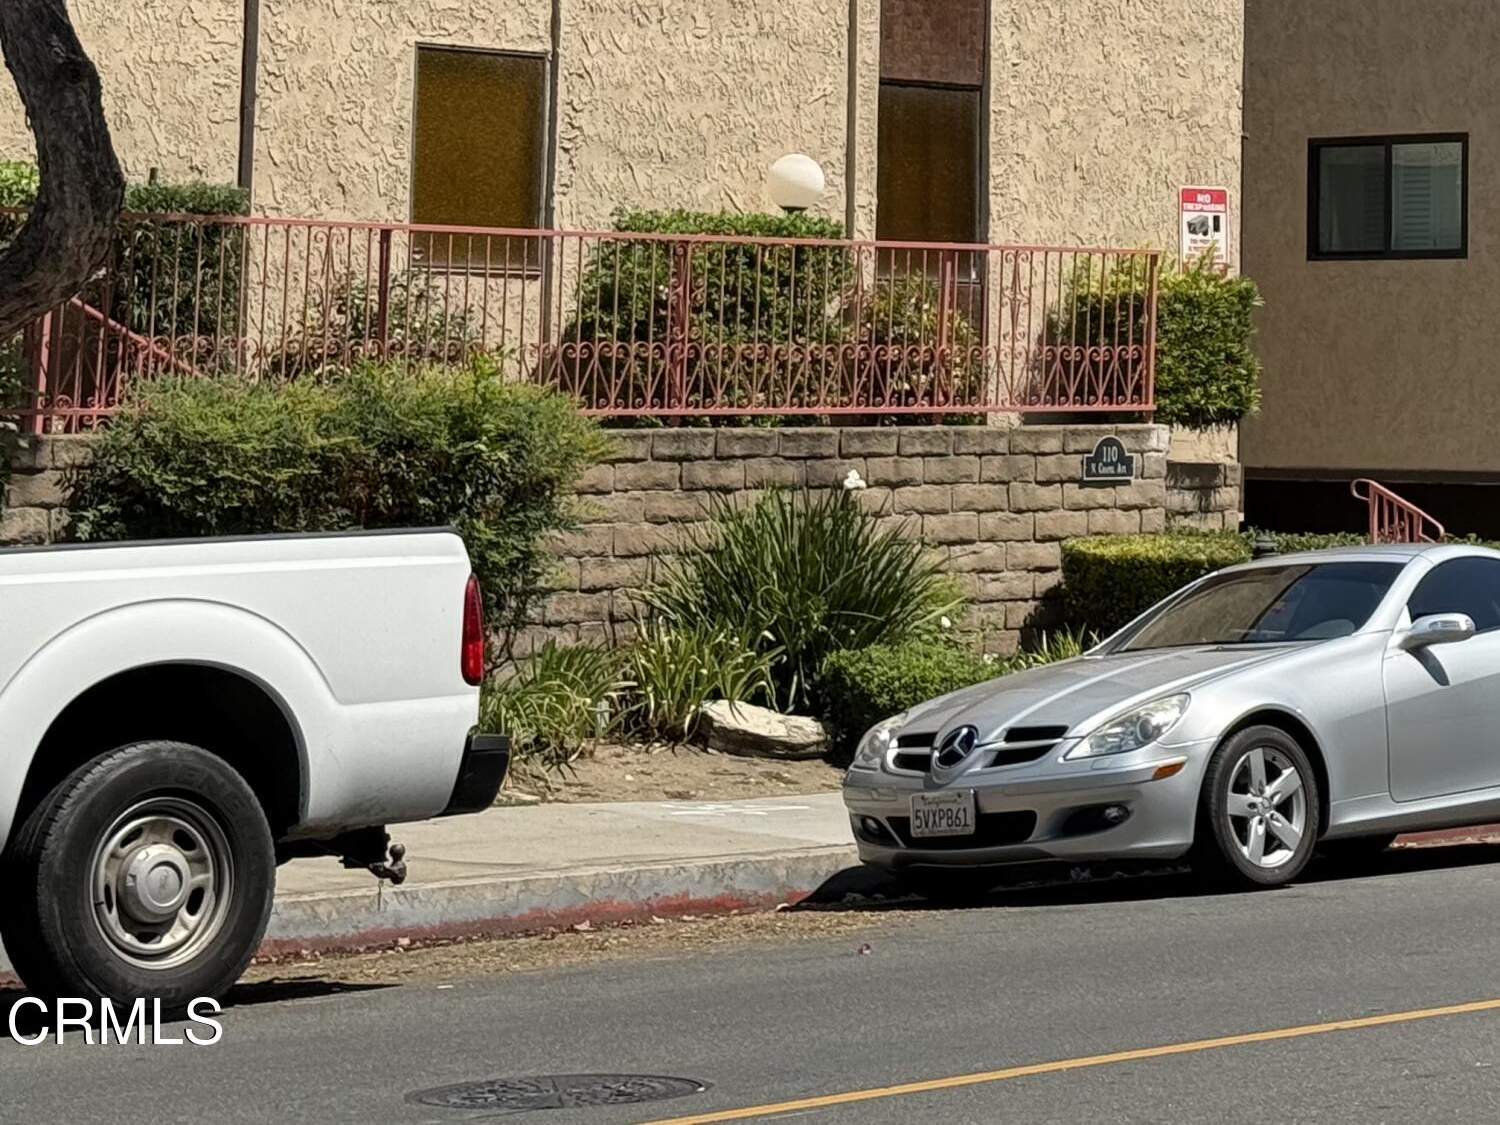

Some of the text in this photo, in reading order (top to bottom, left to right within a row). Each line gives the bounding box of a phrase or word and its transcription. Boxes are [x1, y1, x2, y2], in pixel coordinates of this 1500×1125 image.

[1196, 193, 1212, 204] NO
[1102, 445, 1119, 463] 110
[915, 807, 970, 829] 5VXP861
